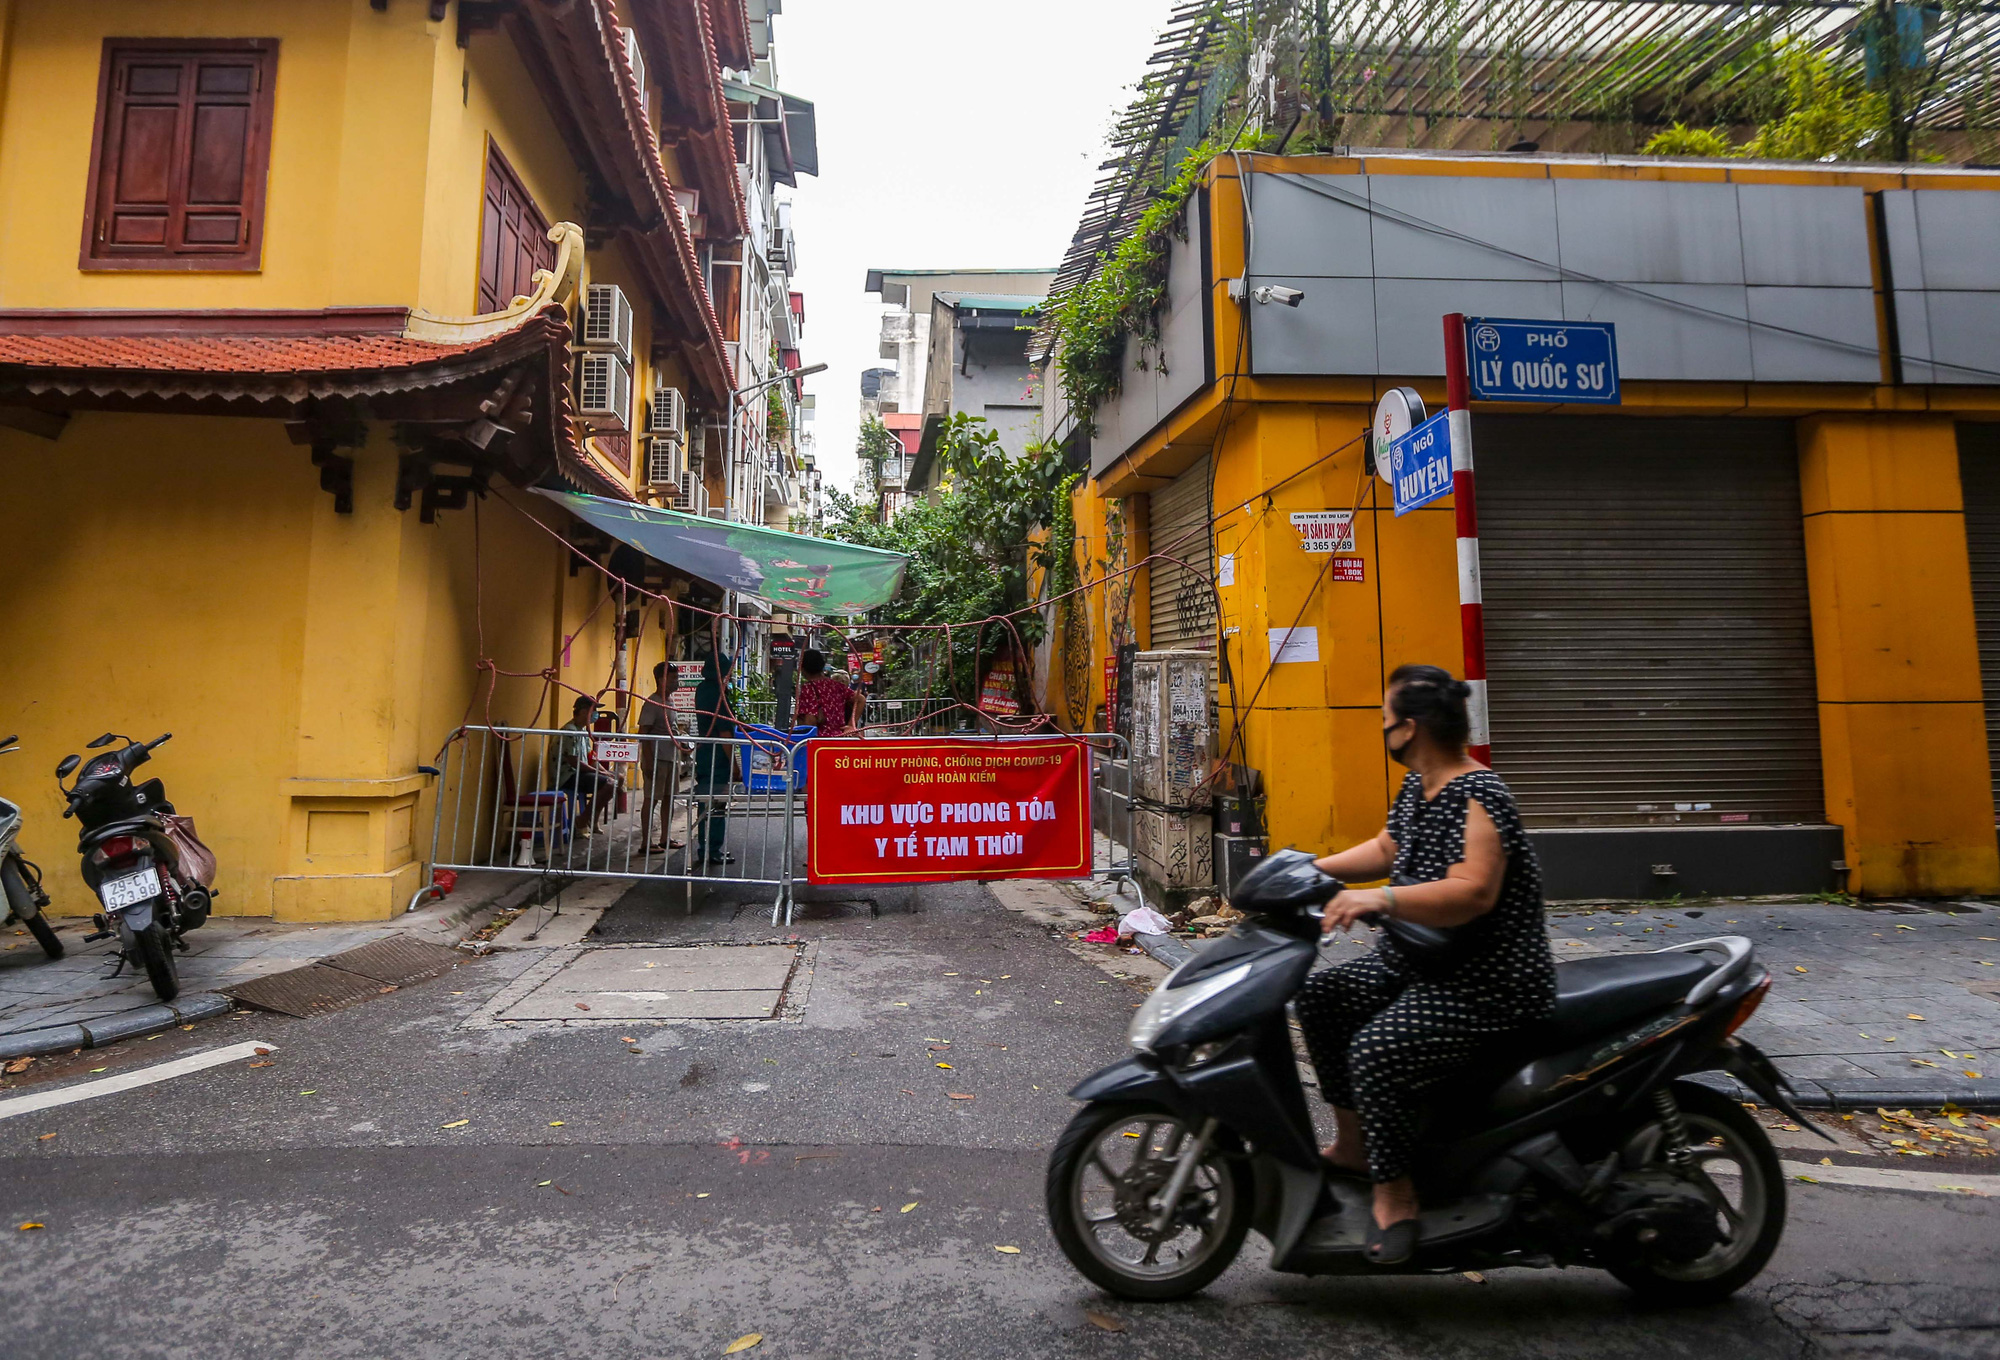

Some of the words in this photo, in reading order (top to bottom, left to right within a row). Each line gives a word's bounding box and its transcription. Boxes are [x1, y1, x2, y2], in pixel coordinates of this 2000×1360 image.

[1526, 328, 1568, 348] PHỐ
[1481, 355, 1502, 387] LÝ
[1512, 354, 1568, 390] QUỐC
[1576, 362, 1605, 390] SƯ
[1412, 428, 1434, 455] NGÕ
[1399, 455, 1449, 503] HUYỆN
[1324, 523, 1335, 539] BAY
[1313, 541, 1329, 550] 365
[835, 755, 850, 769] SỞ
[853, 755, 872, 769] CHỈ
[875, 758, 897, 769] HUY
[901, 755, 941, 768] PHÒNG,
[945, 753, 982, 767] CHỐNG
[985, 757, 1011, 769] DỊCH
[1014, 754, 1062, 767] COVID-19
[903, 771, 934, 786] QUẬN
[937, 770, 967, 783] HOÀN
[970, 769, 996, 783] KIẾM
[841, 804, 884, 825] KHU
[890, 801, 934, 828] VỰC
[941, 801, 1011, 823] PHONG
[1016, 796, 1056, 821] TỎA
[874, 838, 889, 858] Y
[893, 830, 918, 858] TẾ
[923, 836, 968, 860] TẠM
[974, 831, 1023, 856] THỜI
[110, 872, 149, 895] 29-C1
[108, 883, 157, 909] 923.98
